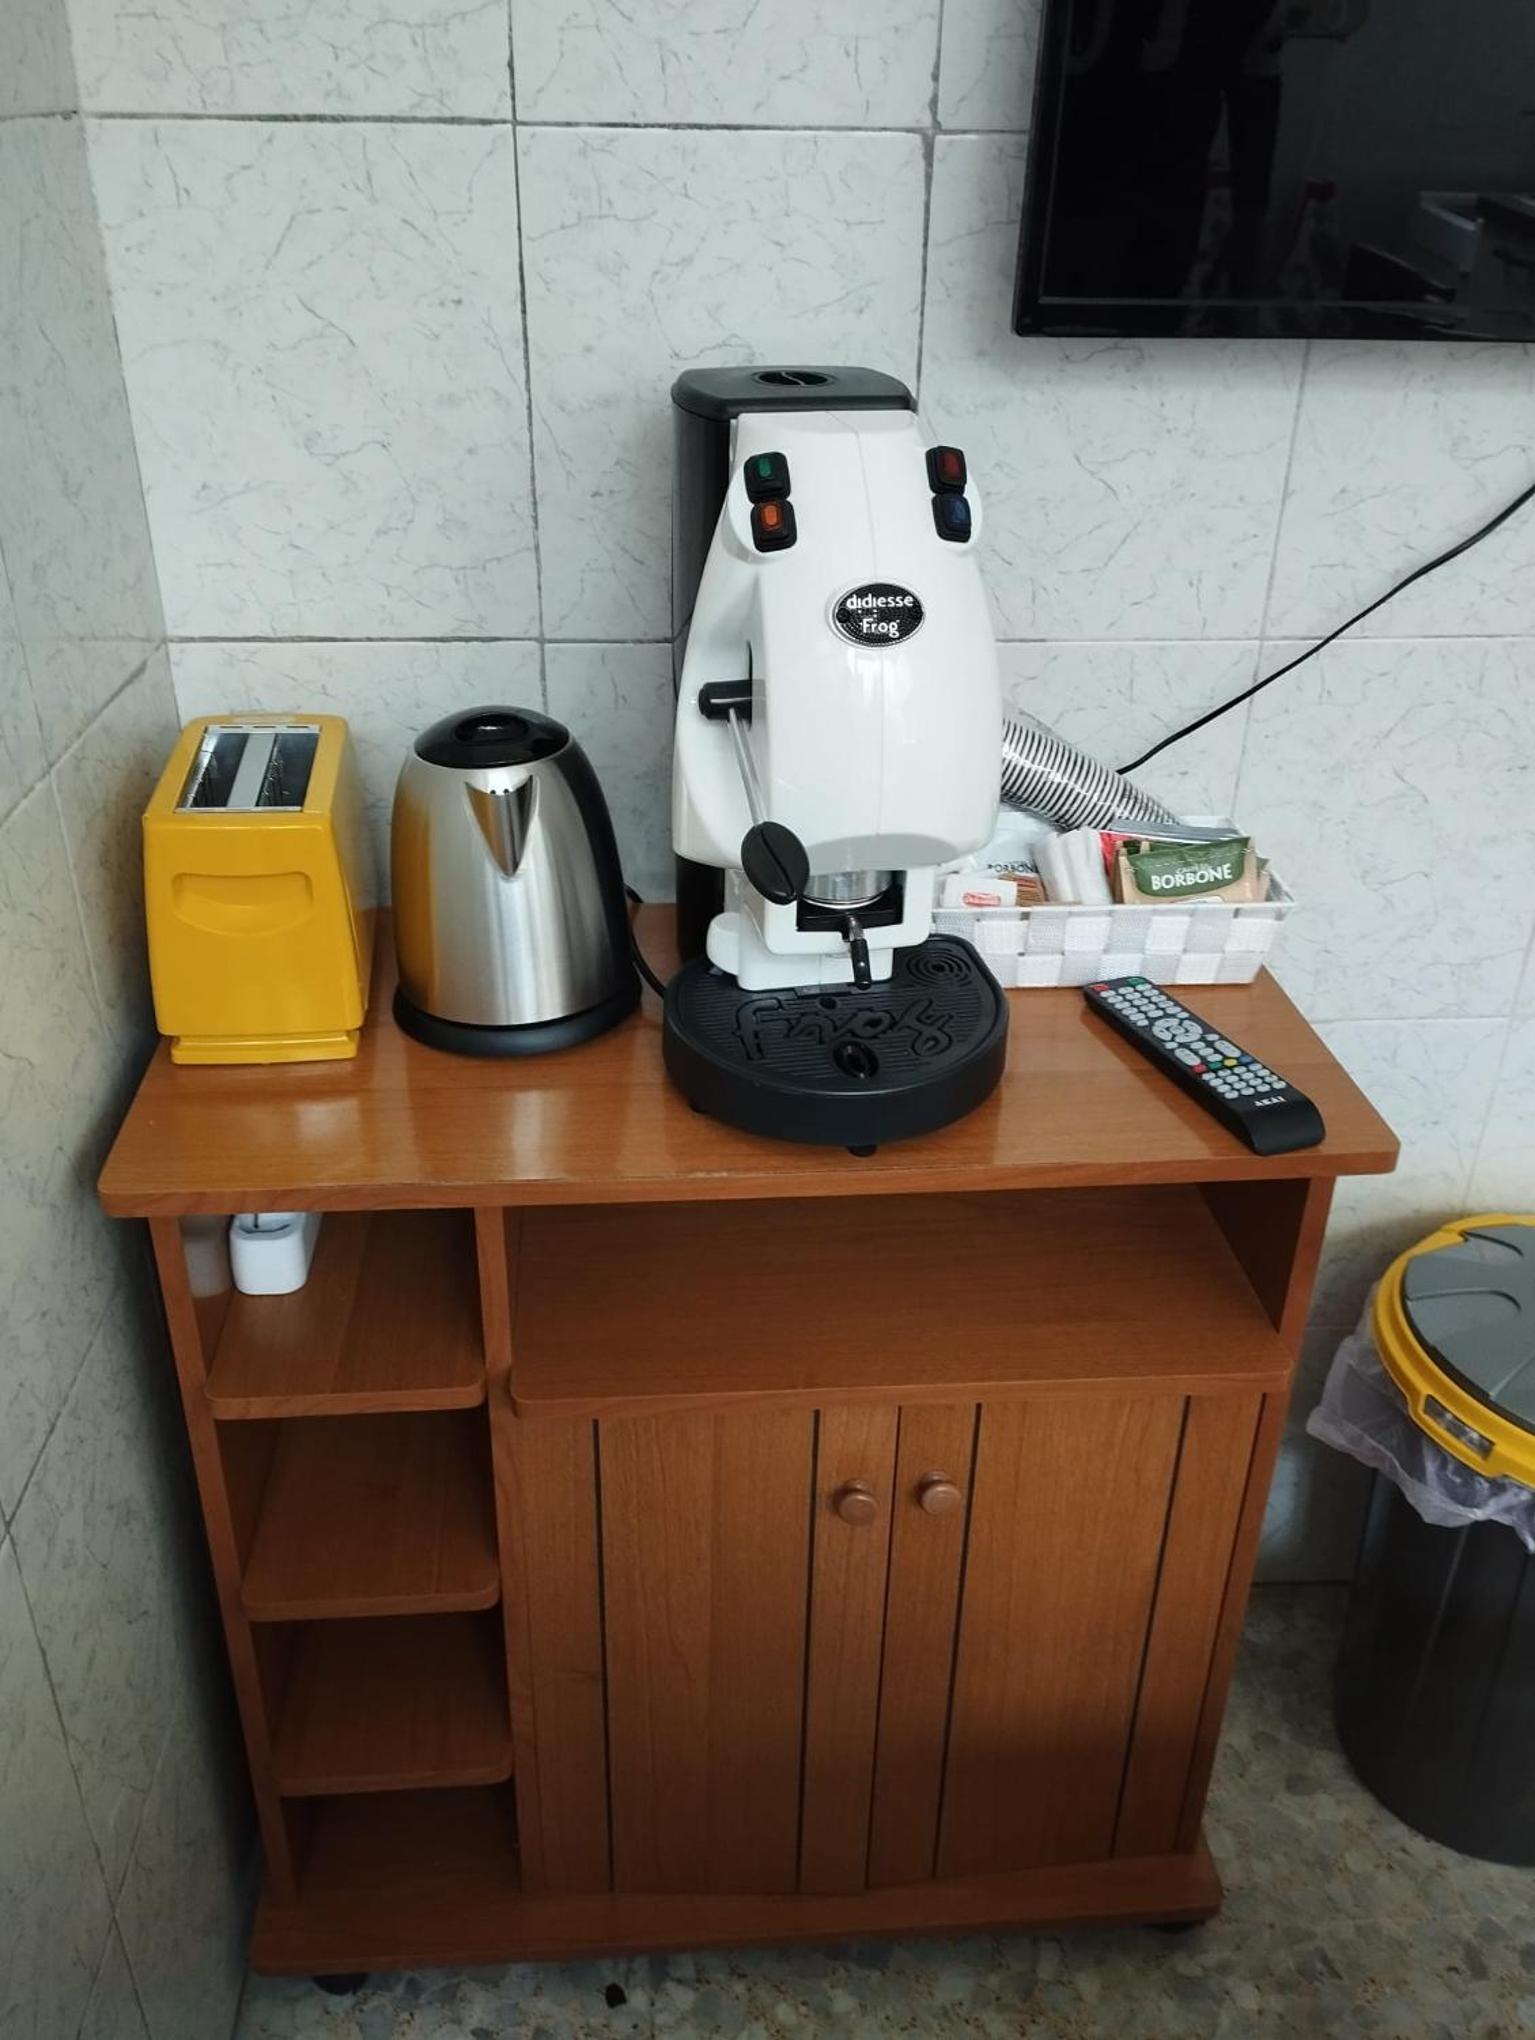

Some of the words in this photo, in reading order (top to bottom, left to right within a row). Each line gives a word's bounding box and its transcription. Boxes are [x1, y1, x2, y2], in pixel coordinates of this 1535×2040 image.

[846, 593, 914, 611] didiesse
[862, 618, 900, 638] Frog
[1151, 864, 1233, 890] BORBONE
